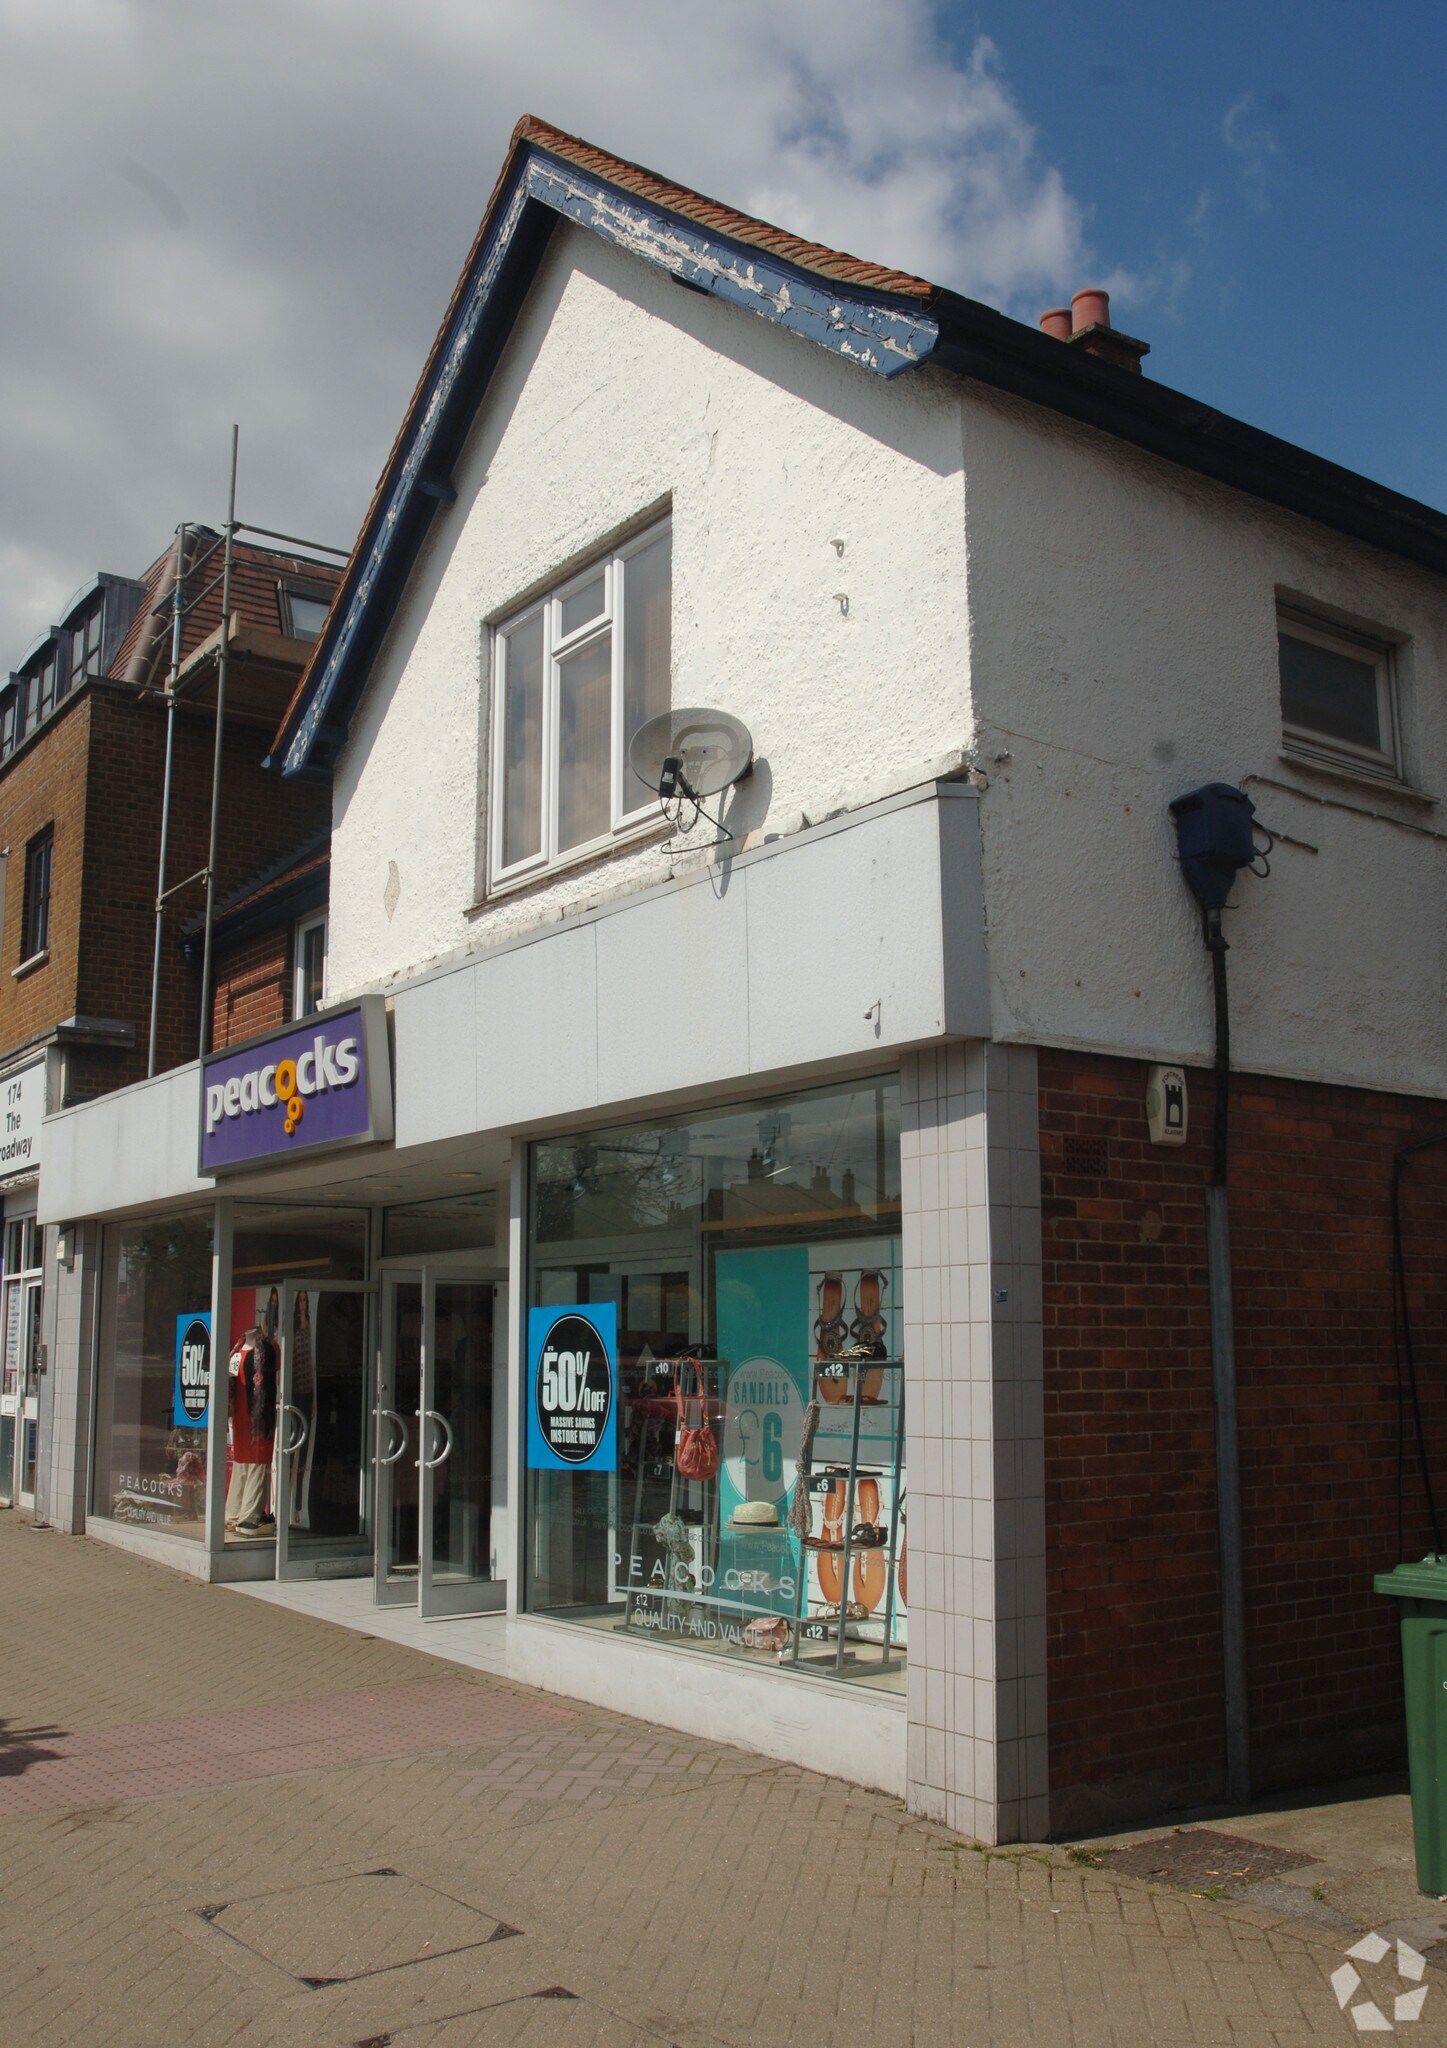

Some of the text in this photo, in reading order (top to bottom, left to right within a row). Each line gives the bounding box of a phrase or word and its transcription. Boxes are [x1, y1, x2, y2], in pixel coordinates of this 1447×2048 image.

[206, 1036, 359, 1134] peacocks
[8, 1081, 22, 1106] 174
[6, 1111, 21, 1133] The
[1164, 1128, 1184, 1137] ALARMS
[655, 1362, 669, 1374] £10
[824, 1363, 844, 1377] £12
[542, 1351, 607, 1412] 50% OFF
[733, 1381, 789, 1405] SANDALS
[550, 1416, 596, 1429] MASSIVE SAVINGS
[550, 1430, 579, 1444] INSTORE
[653, 1464, 663, 1475] £7
[119, 1474, 183, 1498] PEACOCKS
[816, 1479, 829, 1492] £6
[609, 1552, 796, 1600] PEACOCKS
[635, 1594, 649, 1607] £12
[634, 1607, 764, 1649] QUALITY AND VALUE
[806, 1625, 824, 1639] £12
